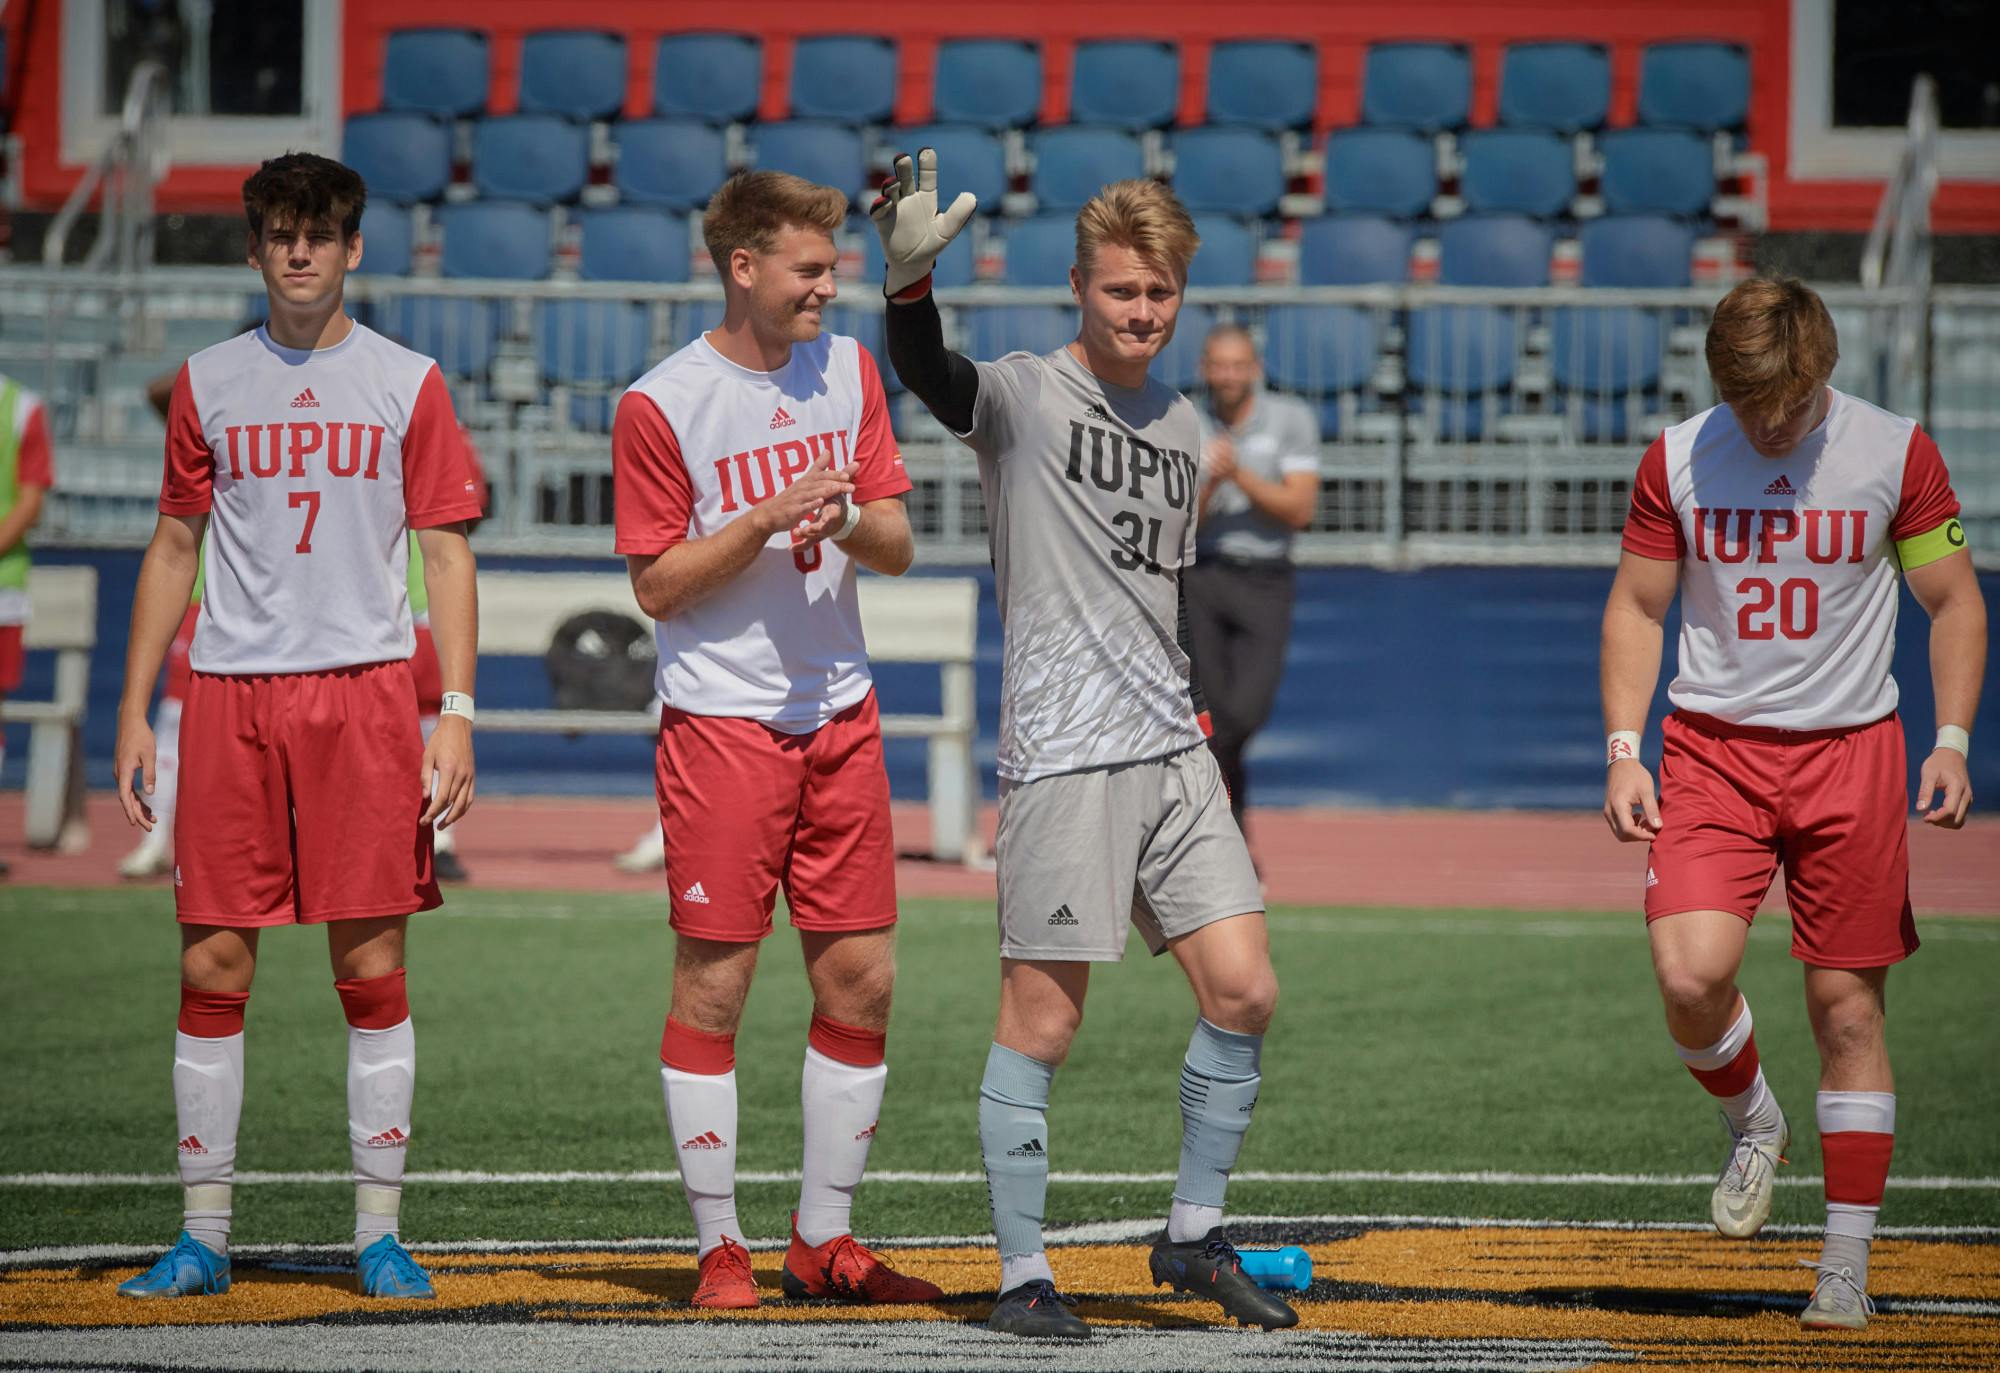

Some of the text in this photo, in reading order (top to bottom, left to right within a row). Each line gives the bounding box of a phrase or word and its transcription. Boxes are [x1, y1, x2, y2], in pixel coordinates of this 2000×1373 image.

[289, 400, 321, 409] adidas
[769, 417, 796, 430] adidas
[225, 421, 385, 480] IUPUI
[1764, 487, 1797, 496] adidas
[288, 491, 320, 553] 7
[1110, 510, 1163, 576] 31
[1693, 508, 1868, 564] IUPUI
[1946, 522, 1965, 546] C
[1736, 577, 1819, 640] 20
[683, 893, 710, 904] adidas
[1047, 917, 1079, 926] adidas
[681, 1141, 728, 1151] adidas
